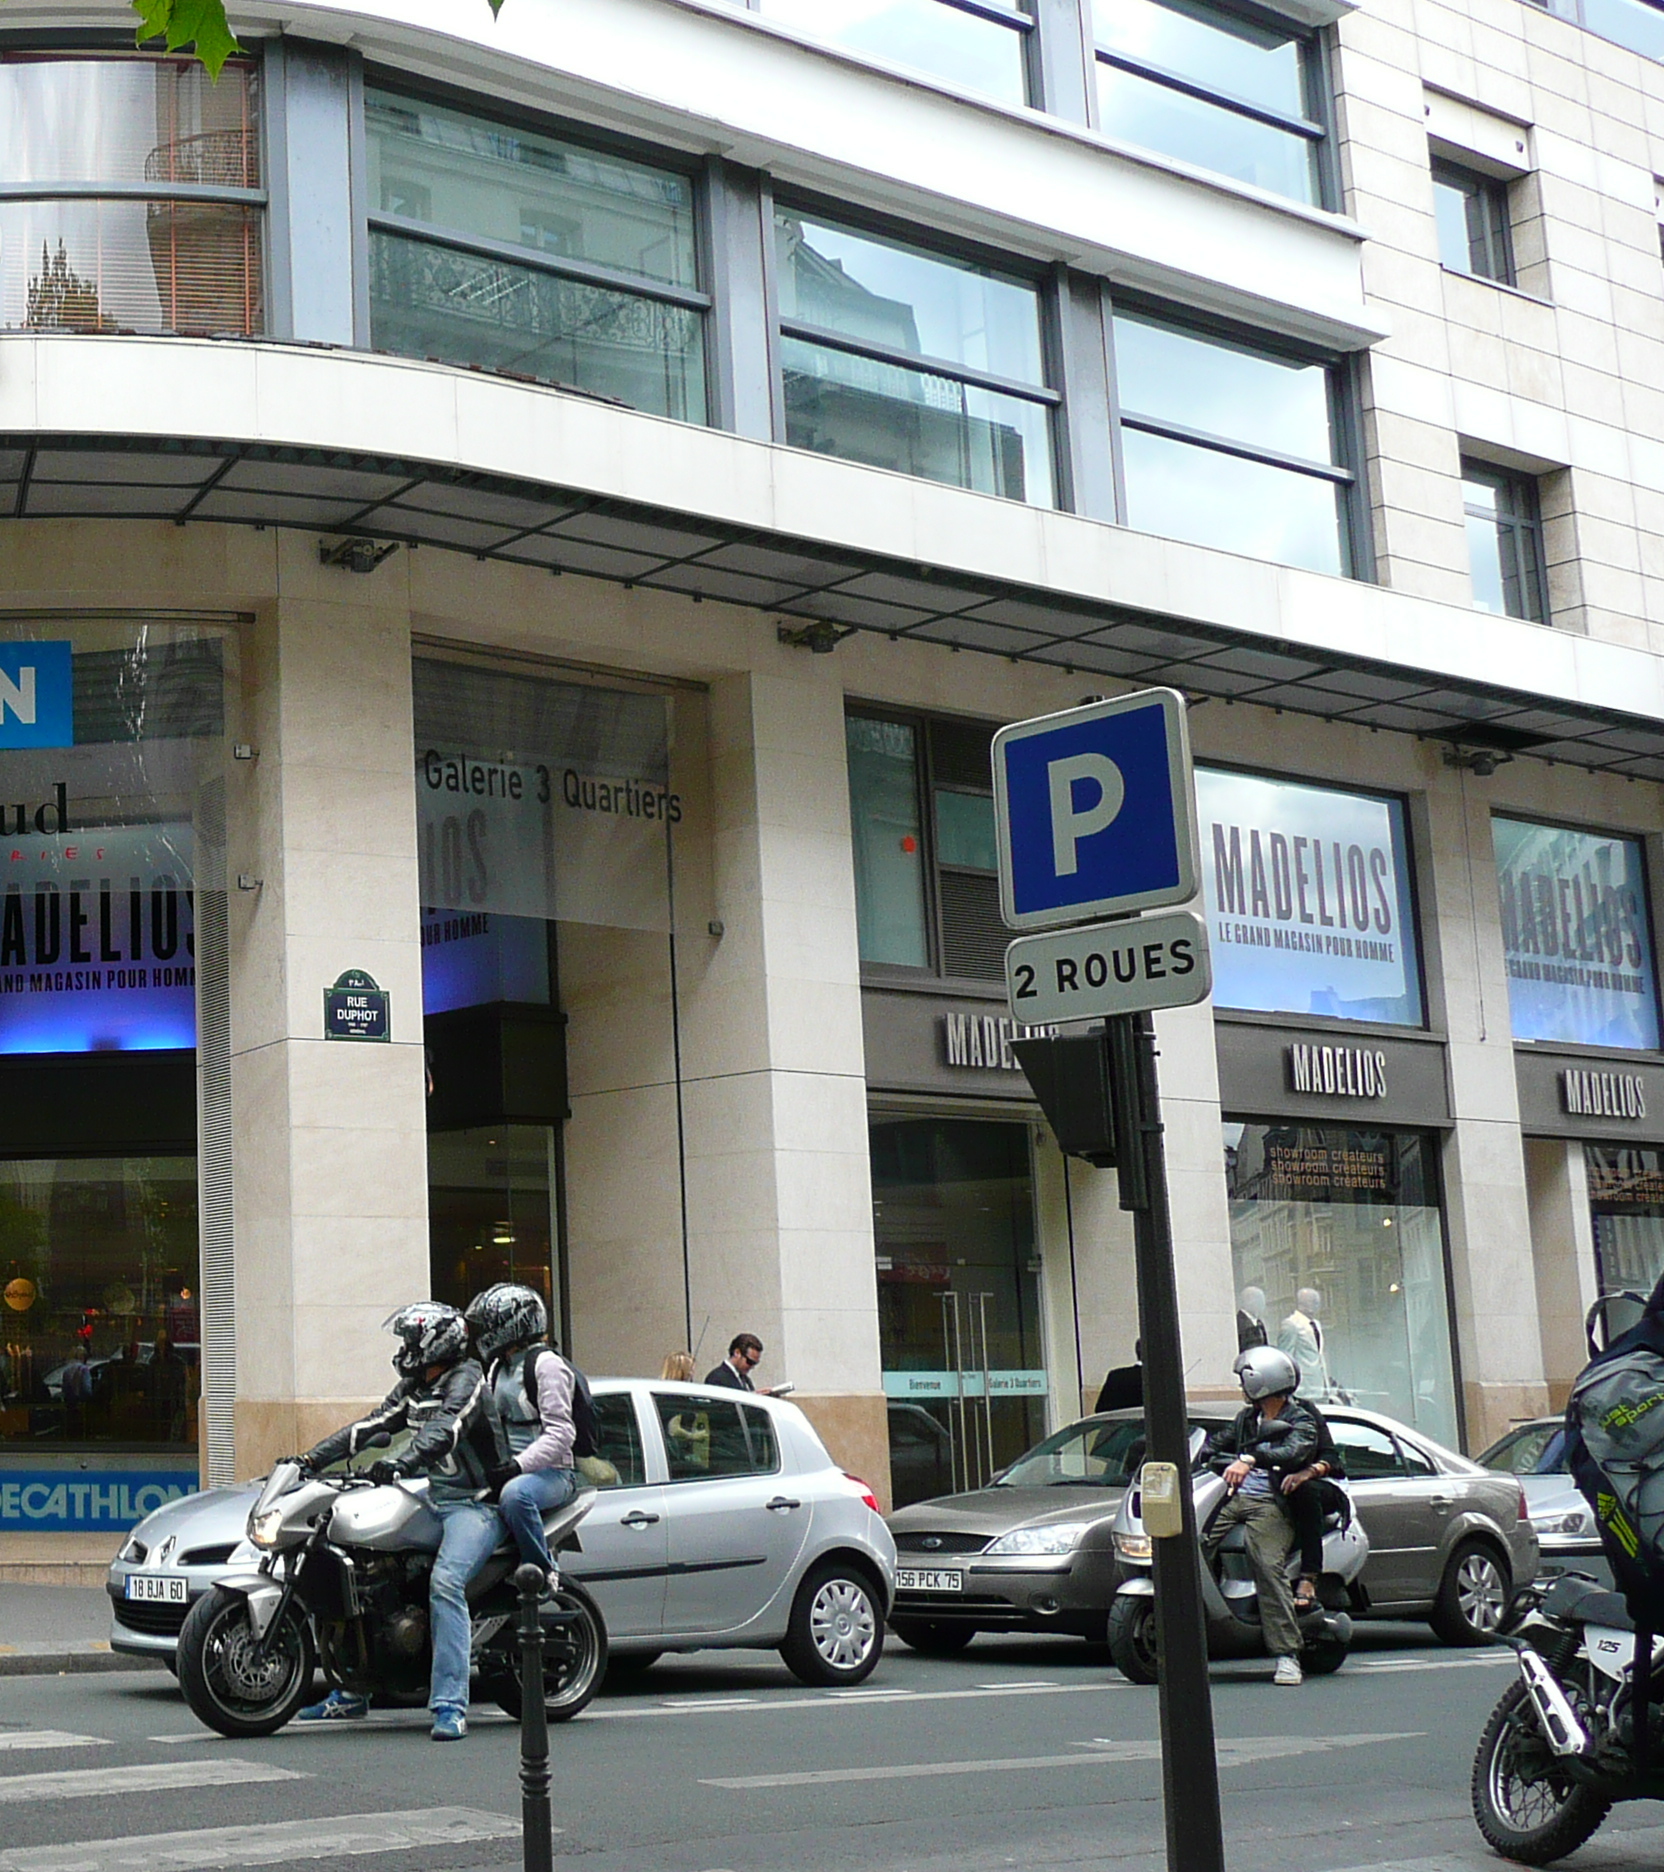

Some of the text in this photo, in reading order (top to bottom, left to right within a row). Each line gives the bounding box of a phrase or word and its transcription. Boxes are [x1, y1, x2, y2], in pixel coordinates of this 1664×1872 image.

[424, 749, 682, 823] Galerie 3 Quartiers
[1047, 753, 1124, 877] P
[1212, 822, 1392, 936] MADELIOS
[444, 911, 489, 943] HOMME
[1218, 921, 1395, 963] LE GRAND MAGASIN POUR HOMME
[30, 970, 101, 992] MAGASIN
[107, 968, 147, 989] POUR
[1014, 939, 1195, 999] 2 ROUES
[347, 996, 368, 1008] RUE
[337, 1009, 378, 1021] DUPHOT
[1292, 1043, 1387, 1098] MADELIOS
[1565, 1069, 1647, 1119] MADELIOS
[1270, 1146, 1327, 1161] showroom
[1271, 1159, 1328, 1174] showroom
[1272, 1172, 1330, 1186] showroom
[134, 1579, 182, 1600] 18 BJA 60
[897, 1571, 959, 1588] 156 PCK 75
[1597, 1640, 1622, 1653] 125
